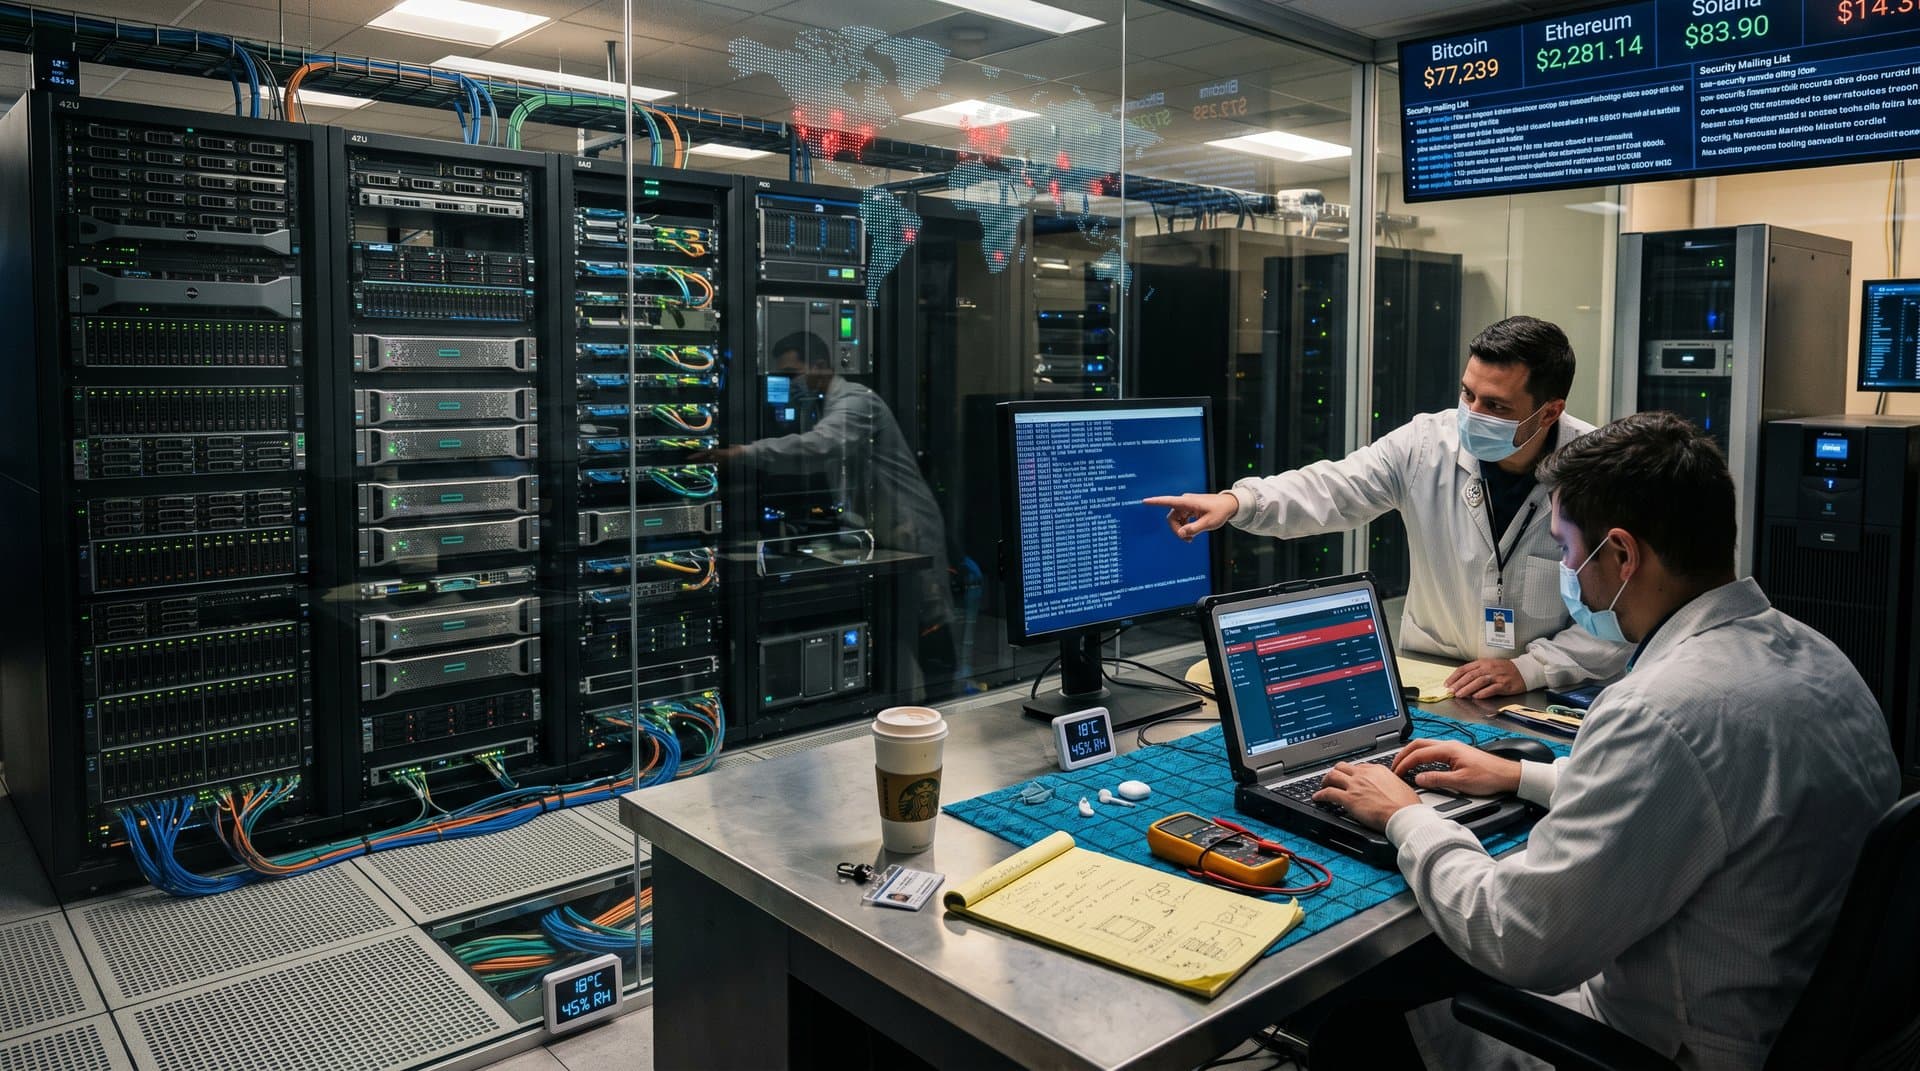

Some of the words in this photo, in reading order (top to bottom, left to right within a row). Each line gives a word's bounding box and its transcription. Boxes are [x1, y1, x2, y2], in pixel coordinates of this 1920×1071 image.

[1838, 0, 1920, 25] $14.3
[1545, 15, 1632, 41] Ethereum
[1685, 15, 1769, 49] $83.90
[1432, 38, 1488, 61] Bitcoin
[1536, 34, 1643, 72] $2,281.14
[1423, 58, 1499, 89] $77,239
[1699, 63, 1737, 75] Security
[1773, 54, 1791, 64] List
[59, 100, 80, 110] 42U
[1071, 741, 1092, 756] 45%
[575, 972, 603, 993] 18°C
[562, 996, 590, 1016] 45%
[593, 988, 611, 1007] RH
